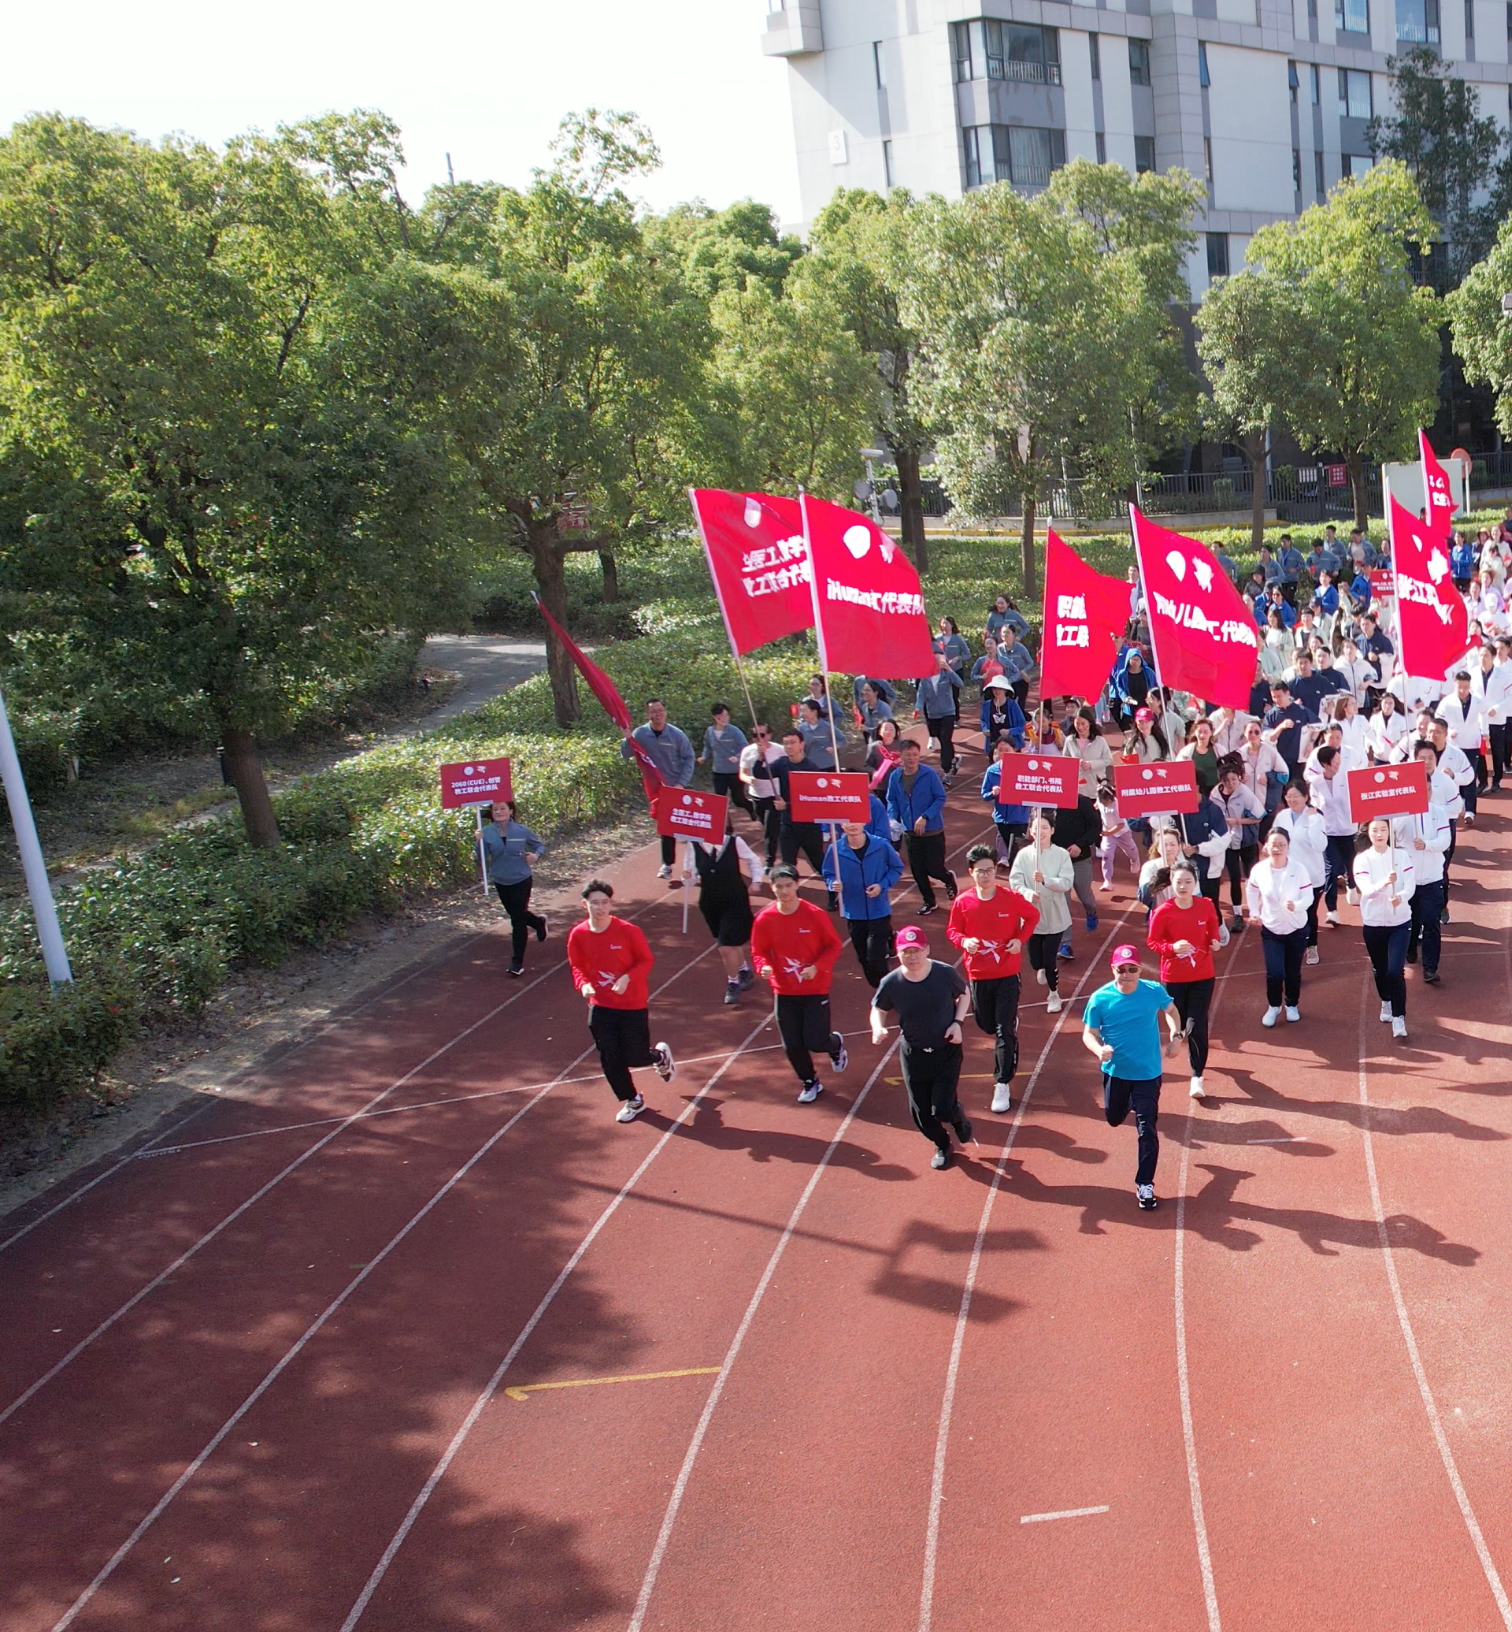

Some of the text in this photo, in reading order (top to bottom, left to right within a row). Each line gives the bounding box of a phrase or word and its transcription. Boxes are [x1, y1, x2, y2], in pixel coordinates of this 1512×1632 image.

[1057, 592, 1087, 619] 职能
[1017, 774, 1062, 785] 职能部门、书院
[1015, 782, 1064, 794] 教工联合代表队
[1121, 784, 1192, 797] 附属幼儿园教工代表队
[1361, 785, 1416, 801] 张江实验室代表队
[799, 794, 862, 803] iHuman教工代表队
